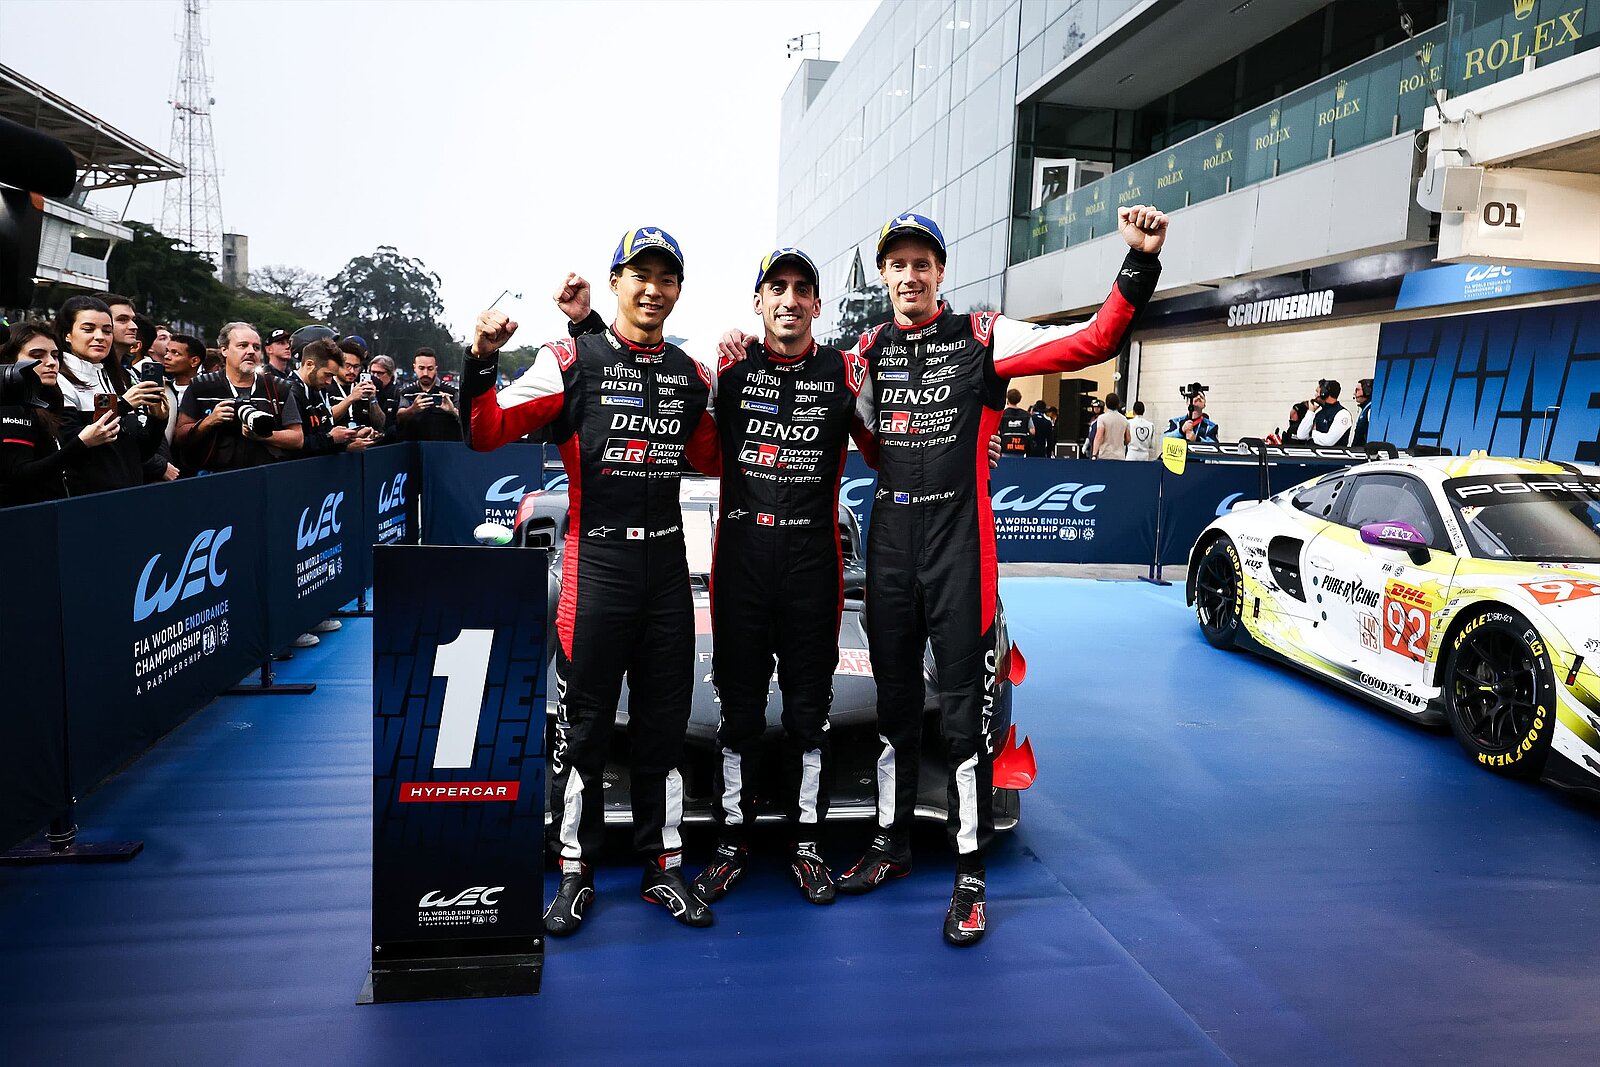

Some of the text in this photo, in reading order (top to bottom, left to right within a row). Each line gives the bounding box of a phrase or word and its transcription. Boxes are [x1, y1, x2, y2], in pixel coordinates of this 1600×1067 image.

[1463, 8, 1584, 80] ROLEX
[1399, 65, 1443, 95] ROLE
[1318, 98, 1361, 127] ROLEX
[1255, 127, 1291, 150] ROLEX
[1203, 149, 1234, 171] ROLEX
[1157, 168, 1184, 189] ROLEX
[1118, 186, 1142, 203] ROLEX
[1085, 201, 1105, 216] ROLEX
[1483, 201, 1521, 228] 01
[1227, 289, 1335, 327] SCRUTINEERING
[926, 342, 955, 353] Mobil
[877, 357, 909, 366] AISIN
[925, 355, 949, 365] ZENT
[603, 362, 642, 379] FUJITSU
[655, 372, 678, 384] Mobil
[746, 369, 780, 386] FUJITSU
[922, 364, 960, 378] WEC
[601, 381, 643, 392] AISIN
[658, 387, 675, 396] ZENT
[741, 386, 780, 399] AISIN
[795, 380, 822, 391] Mobil
[794, 394, 818, 403] ZENT
[881, 385, 951, 405] DENSO
[658, 400, 685, 409] WEC
[792, 406, 829, 416] WEC
[911, 416, 953, 427] GAZOO
[913, 407, 958, 420] TOYOTA
[610, 413, 681, 435] DENSO
[746, 418, 819, 442] DENSO
[880, 419, 907, 433] GR
[909, 424, 950, 435] Racing
[650, 442, 684, 451] TOYOTA
[910, 434, 957, 449] HYBRID
[605, 447, 644, 462] GR
[648, 449, 680, 458] GAZOO
[741, 449, 775, 466] GR
[779, 455, 818, 463] GAZOO
[781, 448, 823, 457] TOYOTA
[647, 457, 678, 466] Racing
[777, 463, 816, 472] Racing
[602, 468, 646, 478] RACING
[378, 472, 408, 514] WEC
[991, 482, 1106, 512] WEC
[485, 508, 501, 517] FIA
[296, 491, 344, 551] WEC
[995, 525, 1058, 533] HAMPIONSHIP
[1005, 517, 1039, 525] WORLD
[1041, 517, 1096, 526] ENDURANCE
[133, 526, 233, 622] WEC
[1226, 545, 1243, 615] GOODYEAR
[1390, 583, 1426, 606] DHL
[134, 599, 229, 658] FIA WORLD ENDURANCE
[1363, 616, 1376, 633] LM
[1387, 601, 1426, 657] 92
[1453, 613, 1487, 650] EAGLE
[1362, 632, 1378, 649] GT3
[135, 630, 201, 677] CHAMPIONSHIP
[840, 651, 868, 660] PER
[136, 650, 202, 696] A PARTNERSHIP
[840, 659, 872, 673] AR
[1361, 673, 1421, 707] GOODYEAR
[432, 628, 495, 769] 1
[1478, 705, 1547, 766] GOODYEAR
[410, 786, 508, 797] HYPERCAR
[419, 886, 505, 907] WEC
